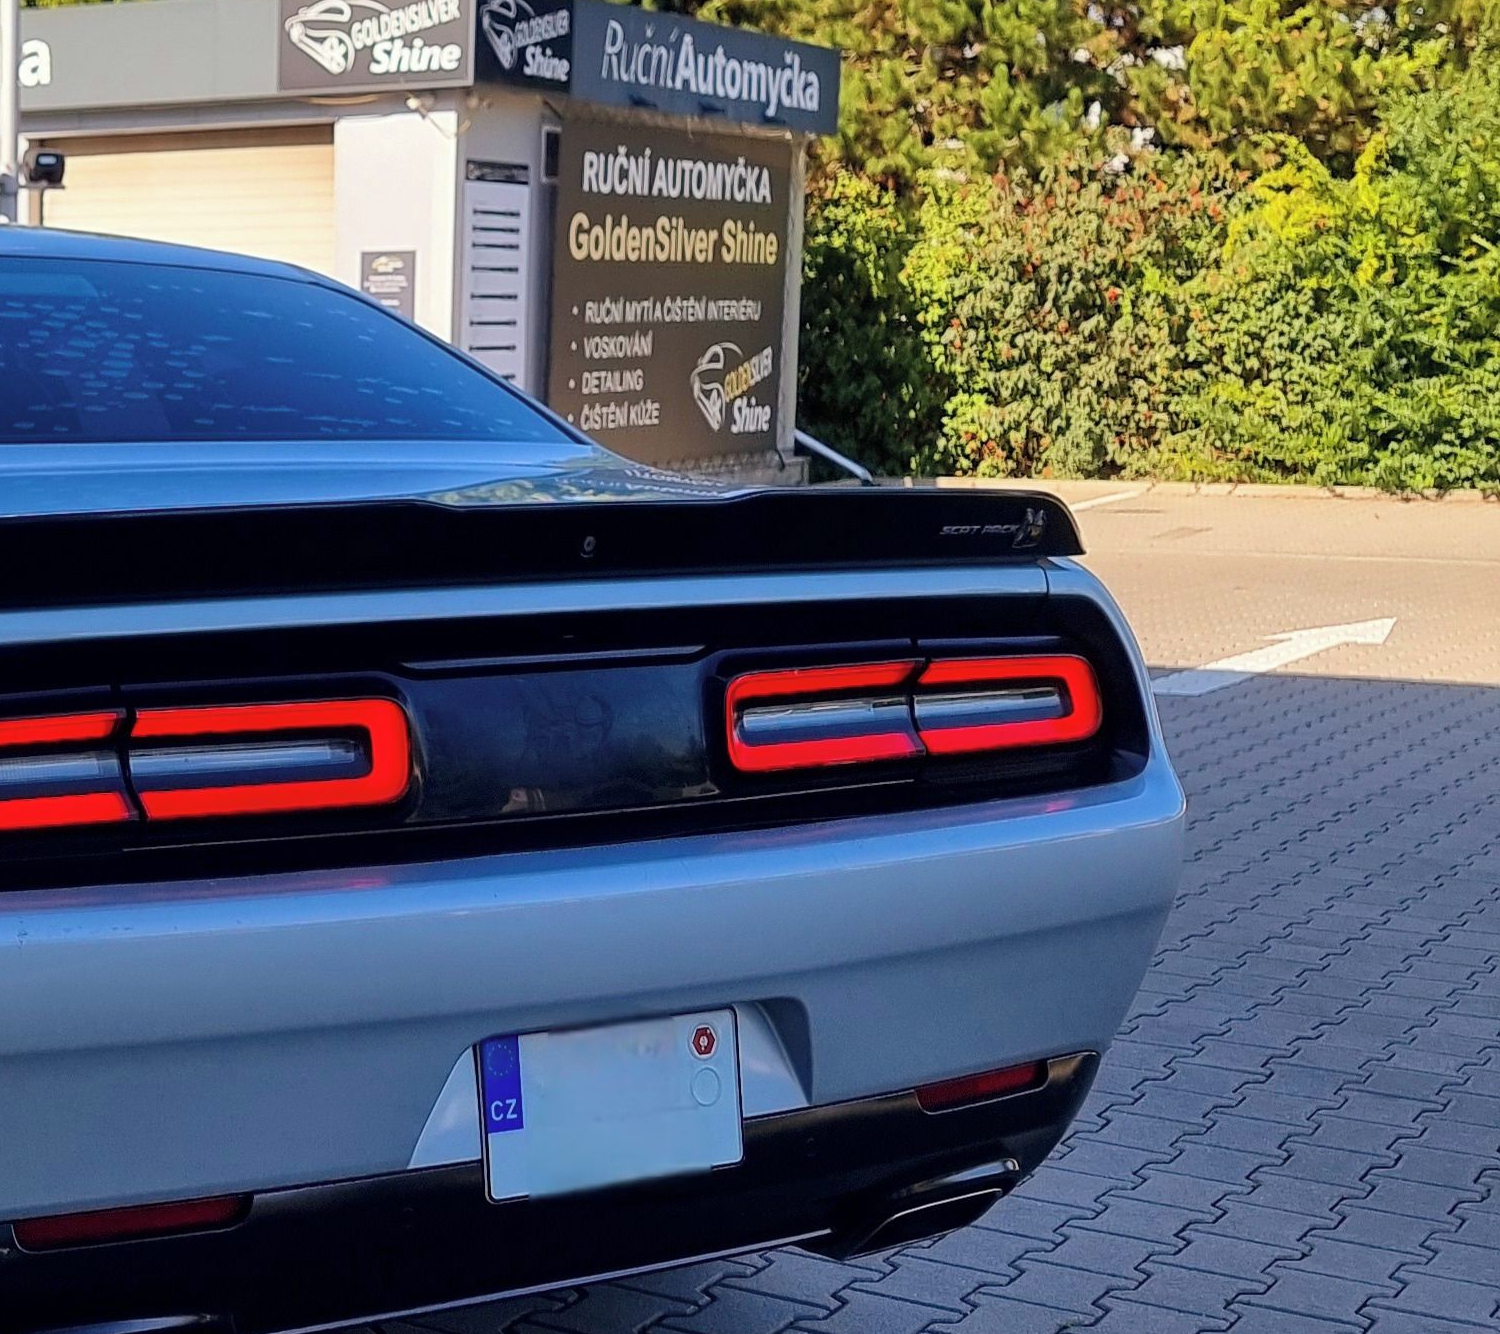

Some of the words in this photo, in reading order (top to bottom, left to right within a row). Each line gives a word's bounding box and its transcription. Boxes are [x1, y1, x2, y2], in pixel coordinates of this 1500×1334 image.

[369, 37, 462, 74] Shine
[523, 45, 570, 82] Shine
[601, 19, 679, 89] Ruční
[674, 33, 821, 117] Automyčka
[582, 145, 652, 197] RUČNÍ
[652, 156, 773, 204] AUTOMYČKA
[569, 212, 719, 263] GoldenSilver
[721, 218, 779, 265] Shine
[583, 329, 653, 359] VOSKOVÁNÍ
[581, 368, 644, 395] DETAILING
[730, 395, 771, 435] Shine
[490, 1098, 518, 1122] CZ
